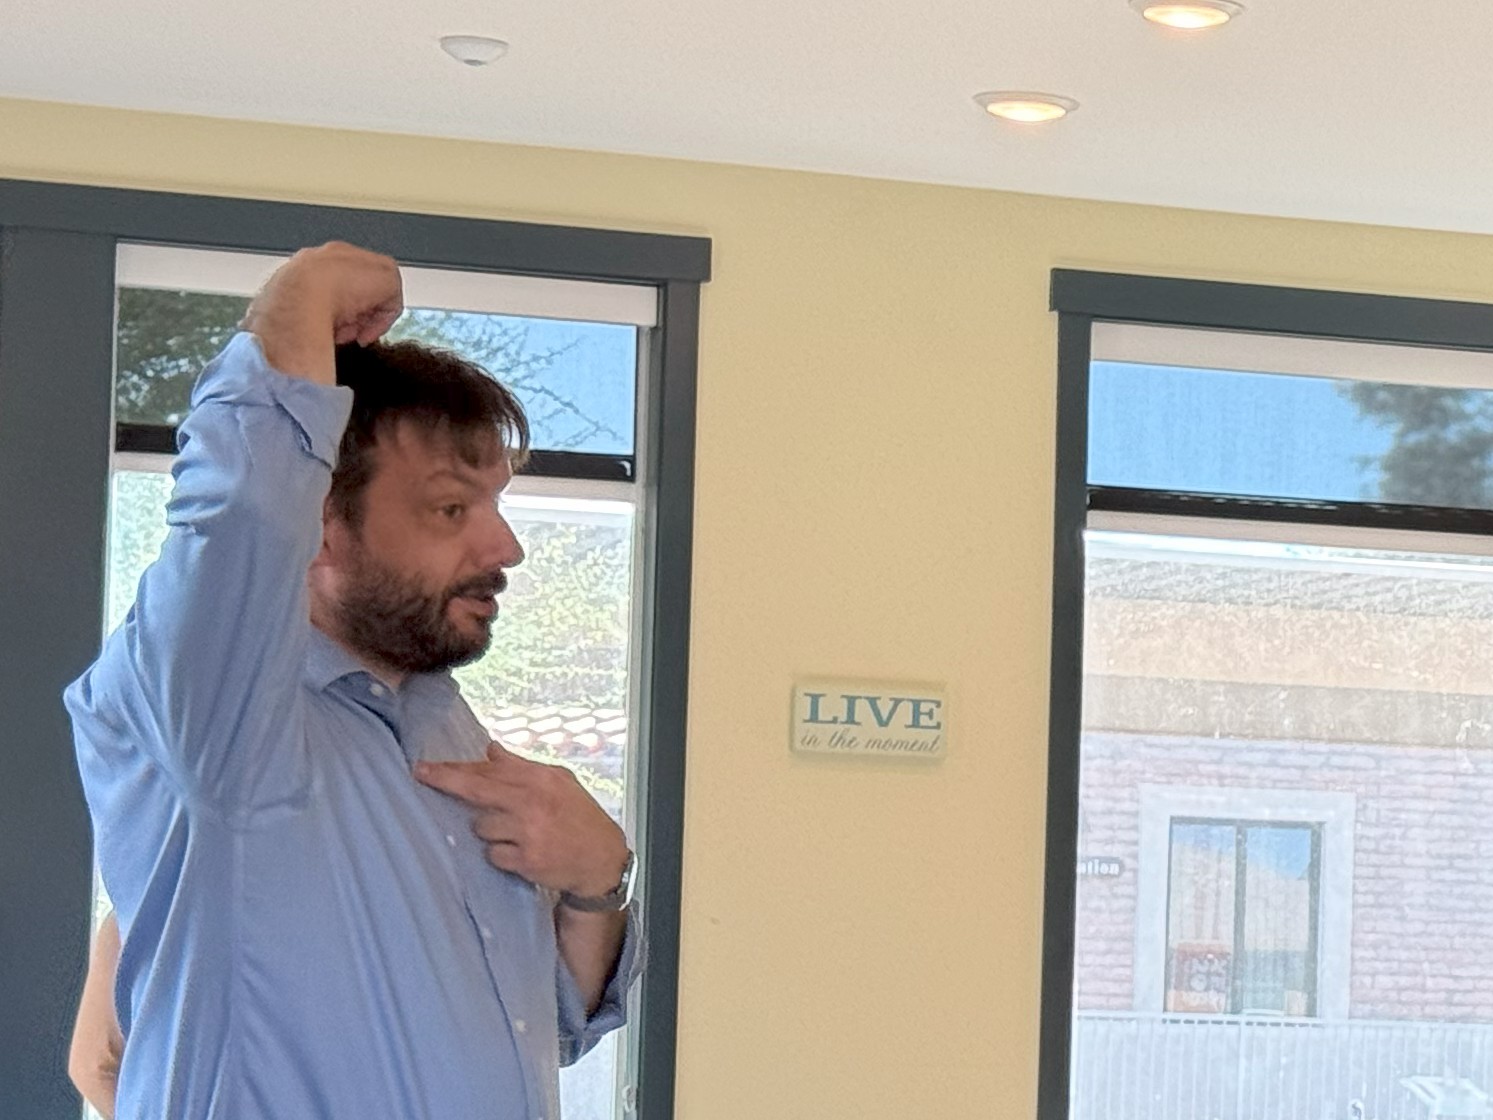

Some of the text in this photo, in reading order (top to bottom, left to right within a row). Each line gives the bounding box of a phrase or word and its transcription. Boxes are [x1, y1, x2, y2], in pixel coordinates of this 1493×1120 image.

[803, 692, 942, 730] LIVE
[801, 728, 941, 754] in the moment
